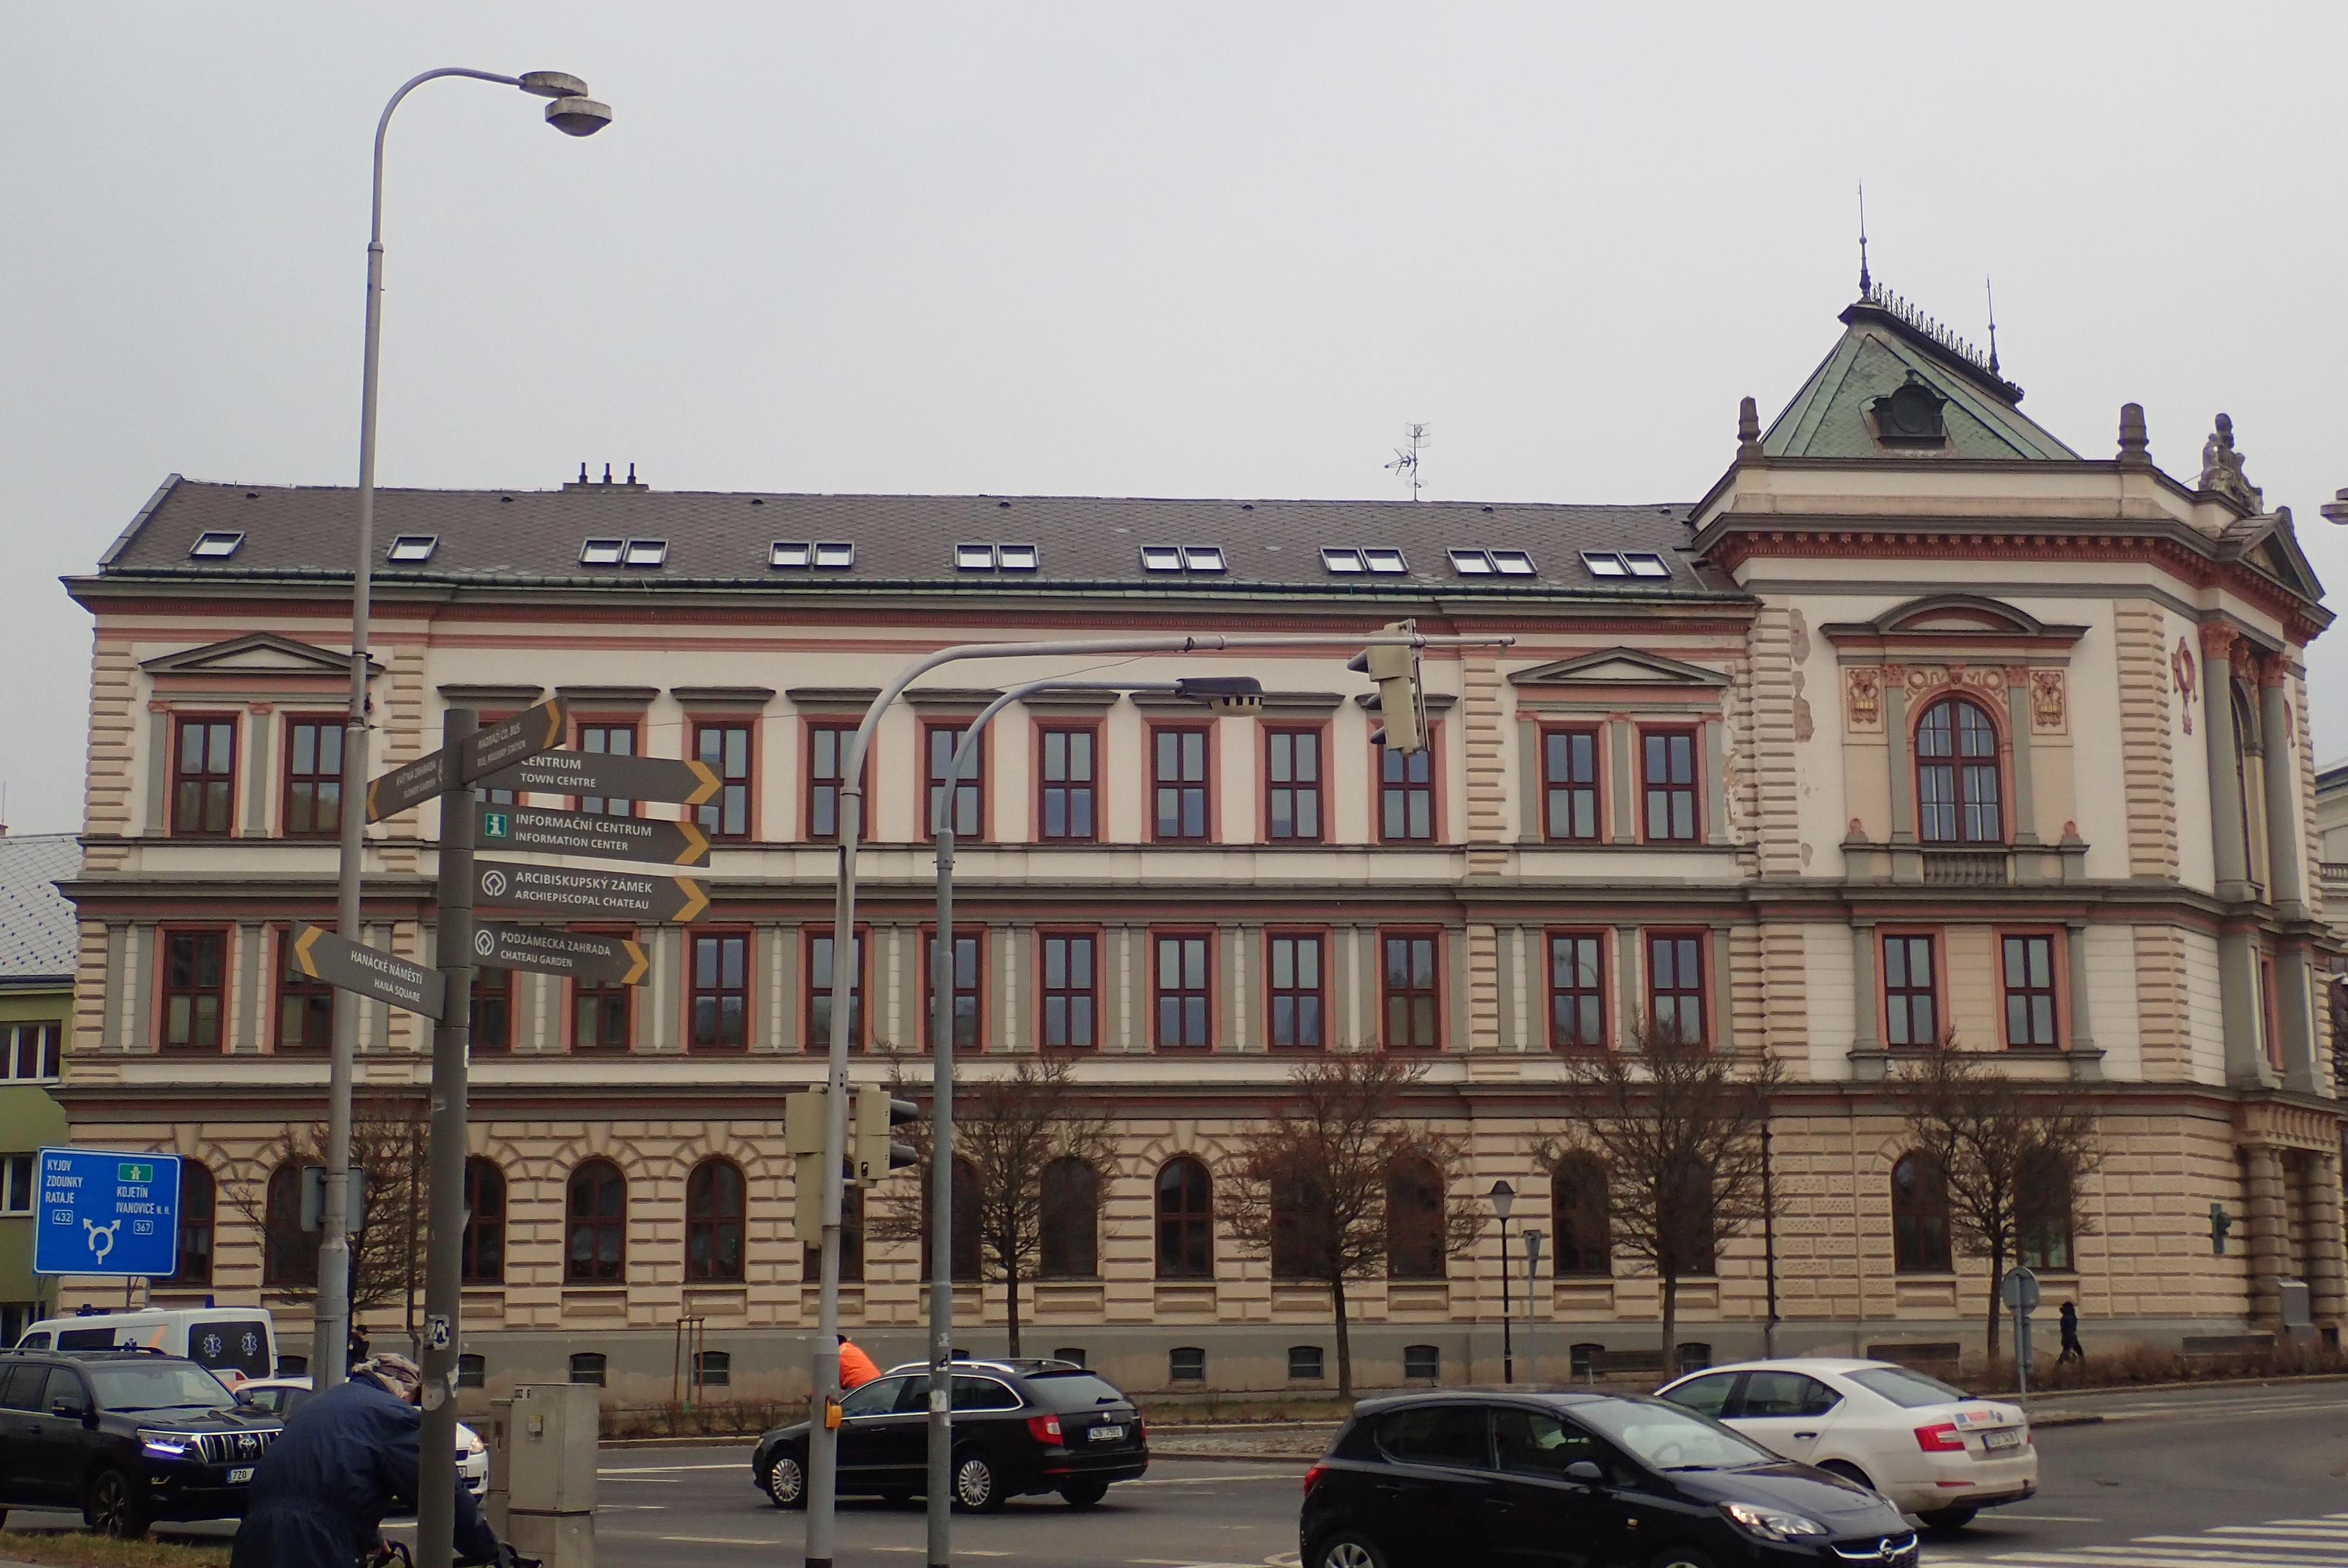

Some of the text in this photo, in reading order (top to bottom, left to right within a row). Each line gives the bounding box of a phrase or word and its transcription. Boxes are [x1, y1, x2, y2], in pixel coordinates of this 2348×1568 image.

[521, 773, 596, 788] TOWN CENTRE
[516, 814, 652, 836] INFORMAČNÍ CENTRUM
[516, 832, 628, 850] INFORMATION CENTER
[515, 872, 653, 893] ARCIBISKUPSKÝ ZÁMEK
[515, 891, 649, 909] ARCHIEPISCOPAL CHATEAU
[501, 932, 610, 956] PODZÁMECKÁ ZAHRADA
[501, 950, 573, 968] CHATEAU GARDEN
[351, 951, 423, 985] HANÁCKÉ NÁMĚSTÍ
[375, 978, 421, 1002] HANÁ SQUARE
[47, 1159, 72, 1171] KYJOV
[46, 1175, 83, 1188] ZDOUNKY
[45, 1191, 75, 1204] RATAJE
[117, 1185, 148, 1198] KOJETÍN
[116, 1202, 154, 1214] IVANOVICE
[55, 1212, 71, 1222] 432
[136, 1223, 150, 1232] 367
